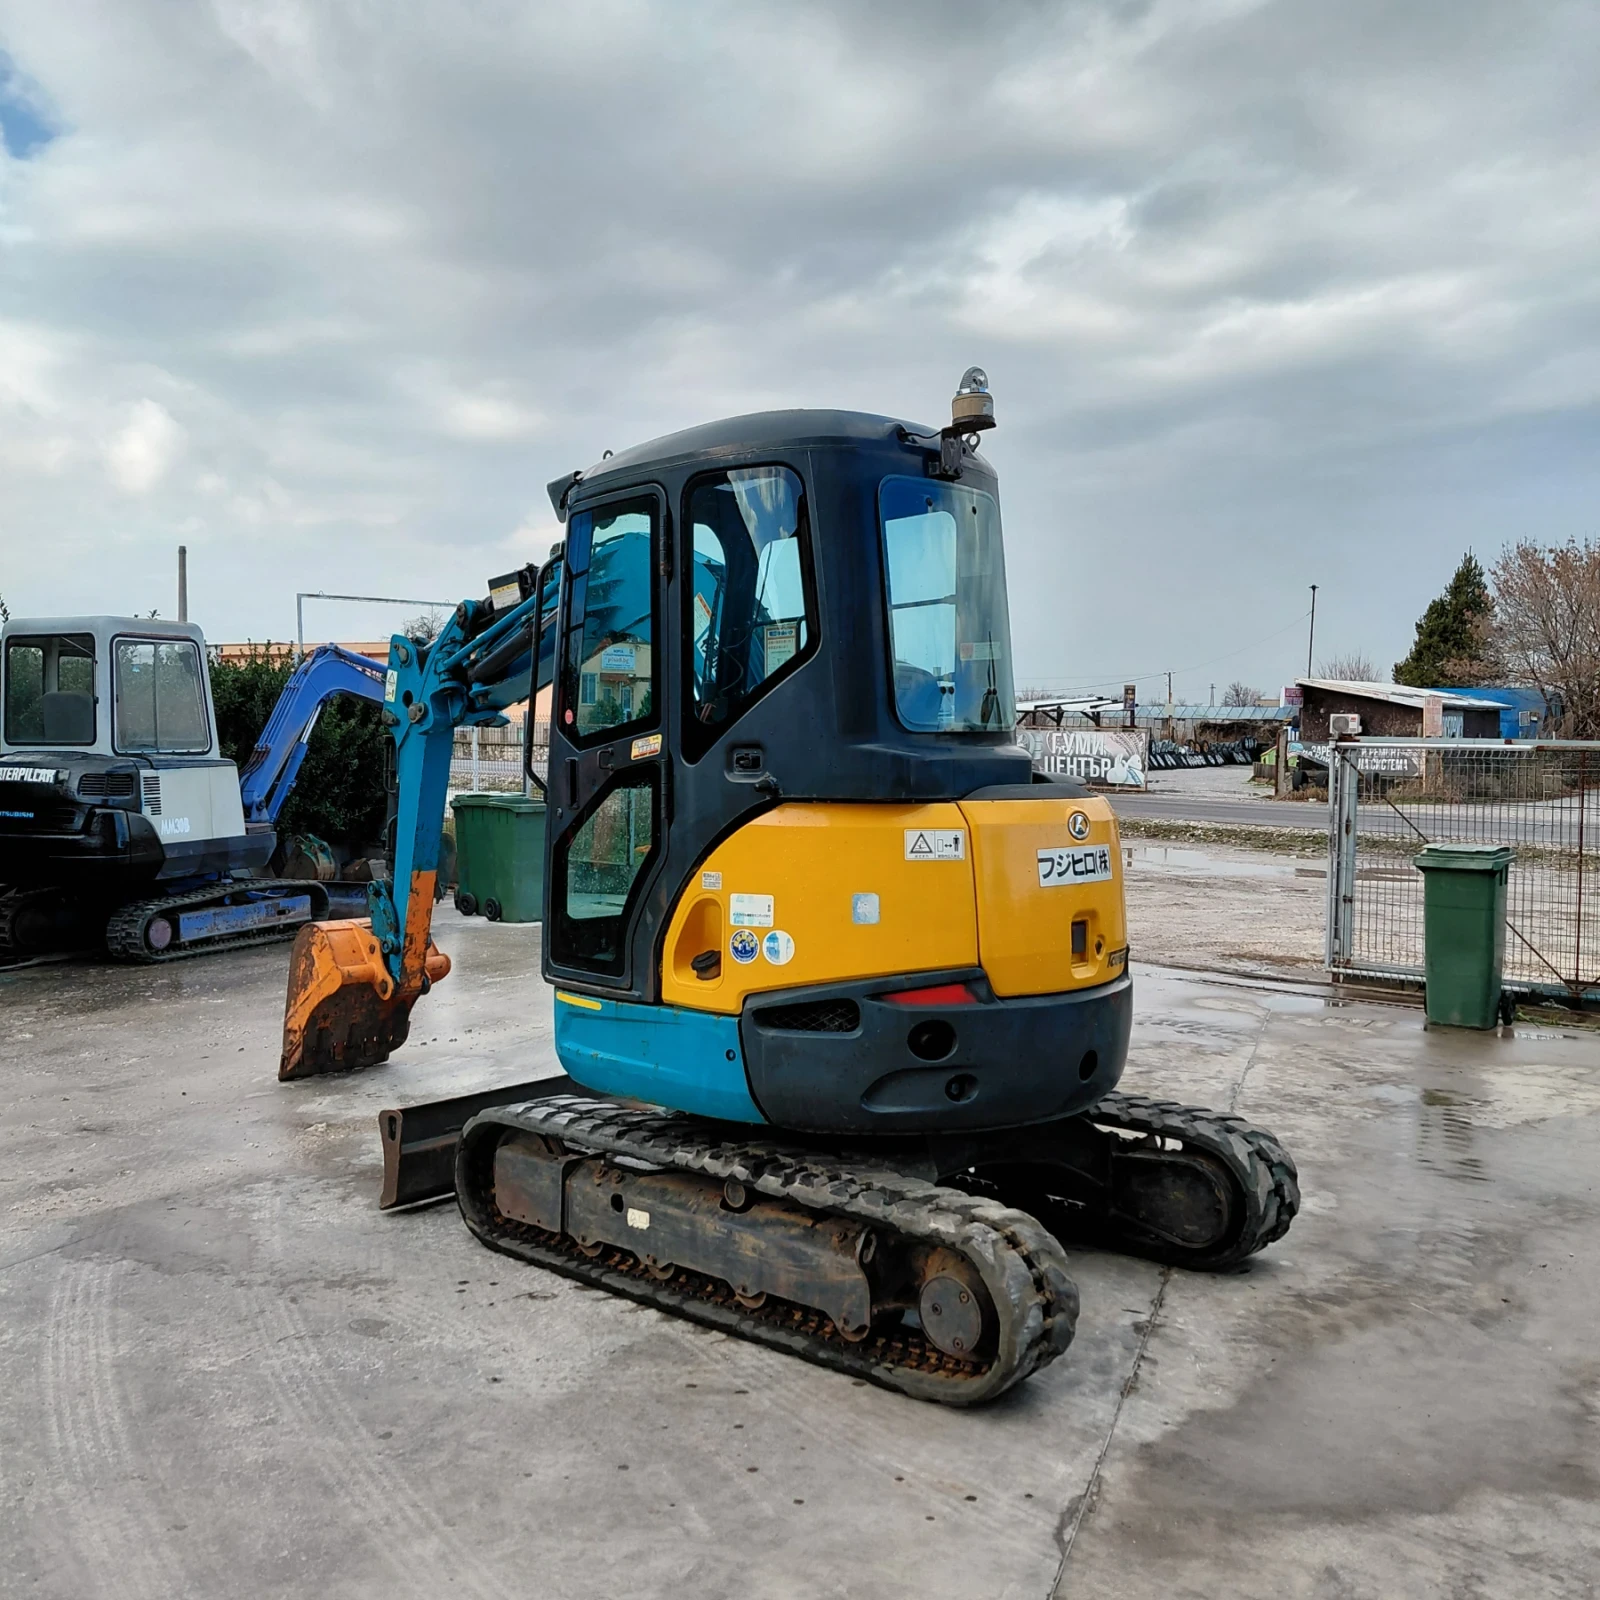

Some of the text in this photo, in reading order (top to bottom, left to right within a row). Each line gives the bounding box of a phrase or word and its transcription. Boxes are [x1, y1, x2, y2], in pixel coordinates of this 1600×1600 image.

[1051, 732, 1105, 756] ГУМИ
[1044, 755, 1112, 778] ЦЕНТЪР
[1370, 757, 1408, 771] СИСТЕМА
[161, 817, 190, 835] MM30B
